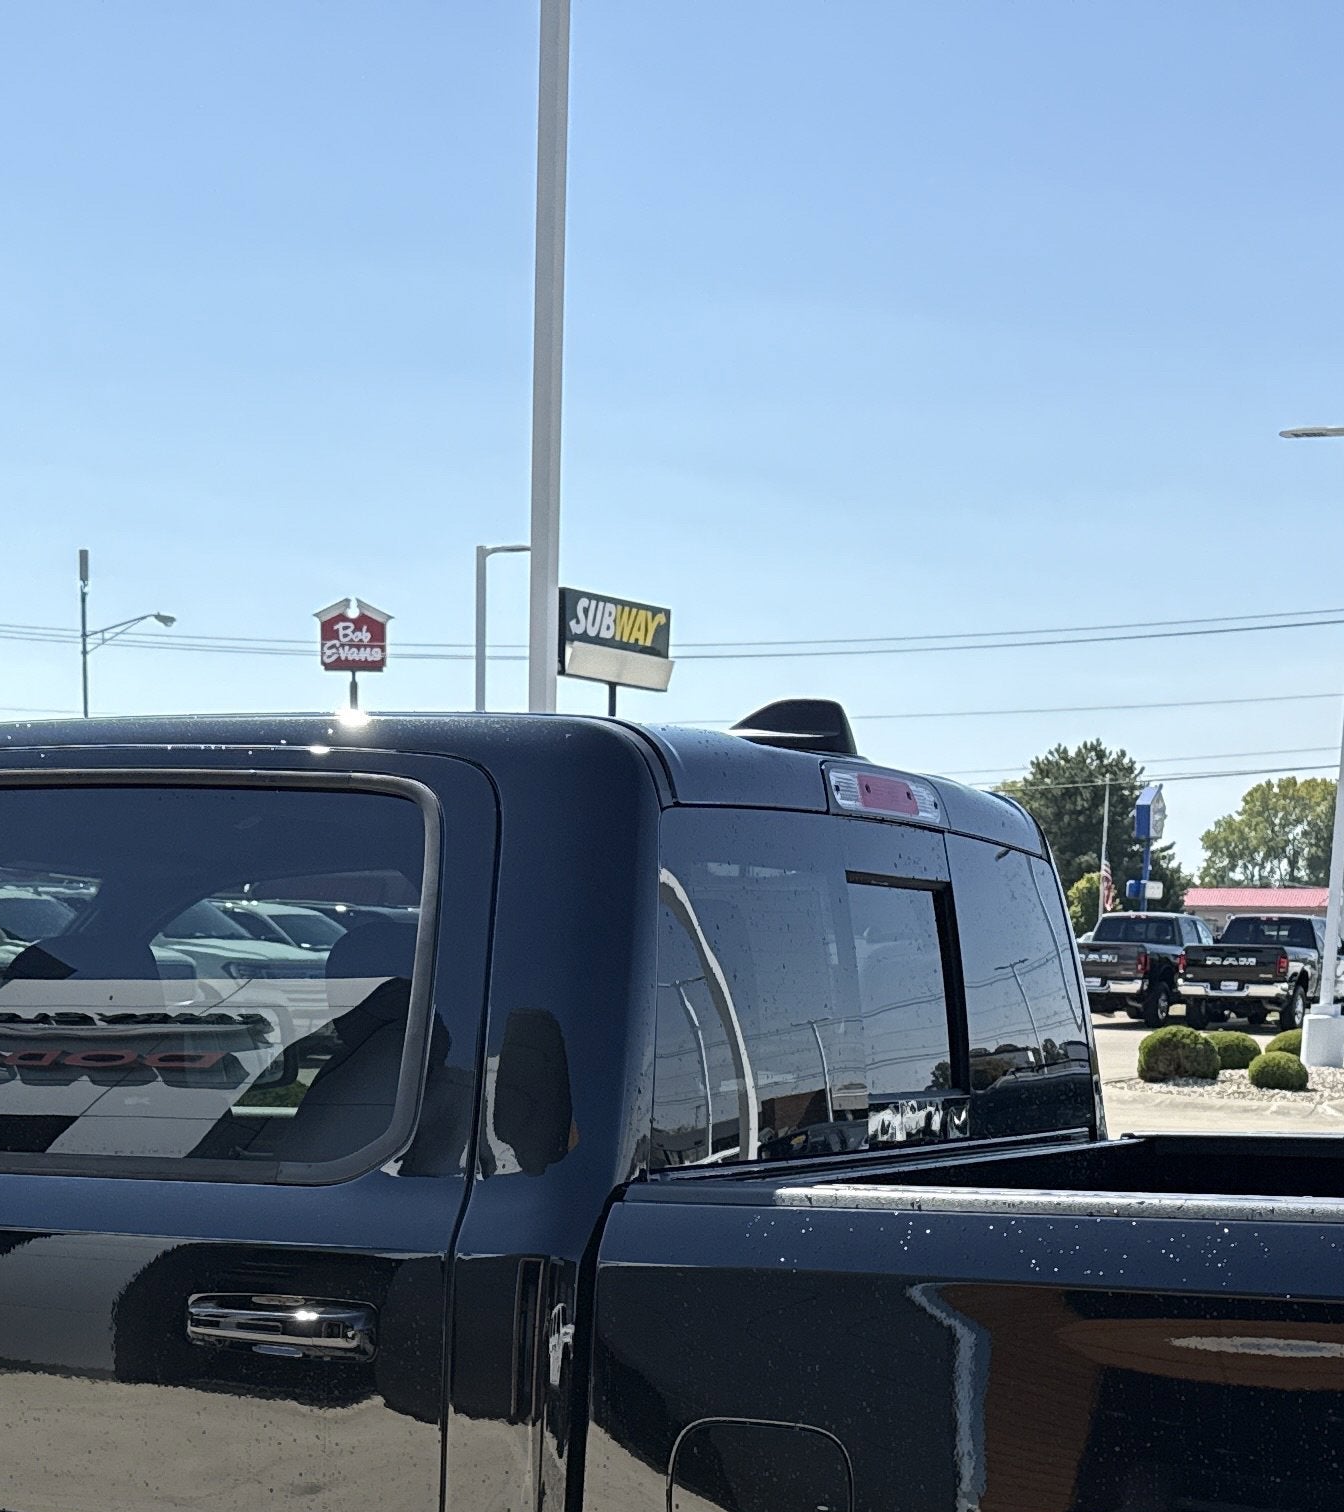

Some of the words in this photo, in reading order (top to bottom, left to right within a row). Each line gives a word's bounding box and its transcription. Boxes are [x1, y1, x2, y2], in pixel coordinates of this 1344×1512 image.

[333, 622, 372, 644] Bob
[569, 598, 666, 647] SUBWAY
[322, 640, 383, 663] Evans
[1205, 956, 1257, 966] RAM
